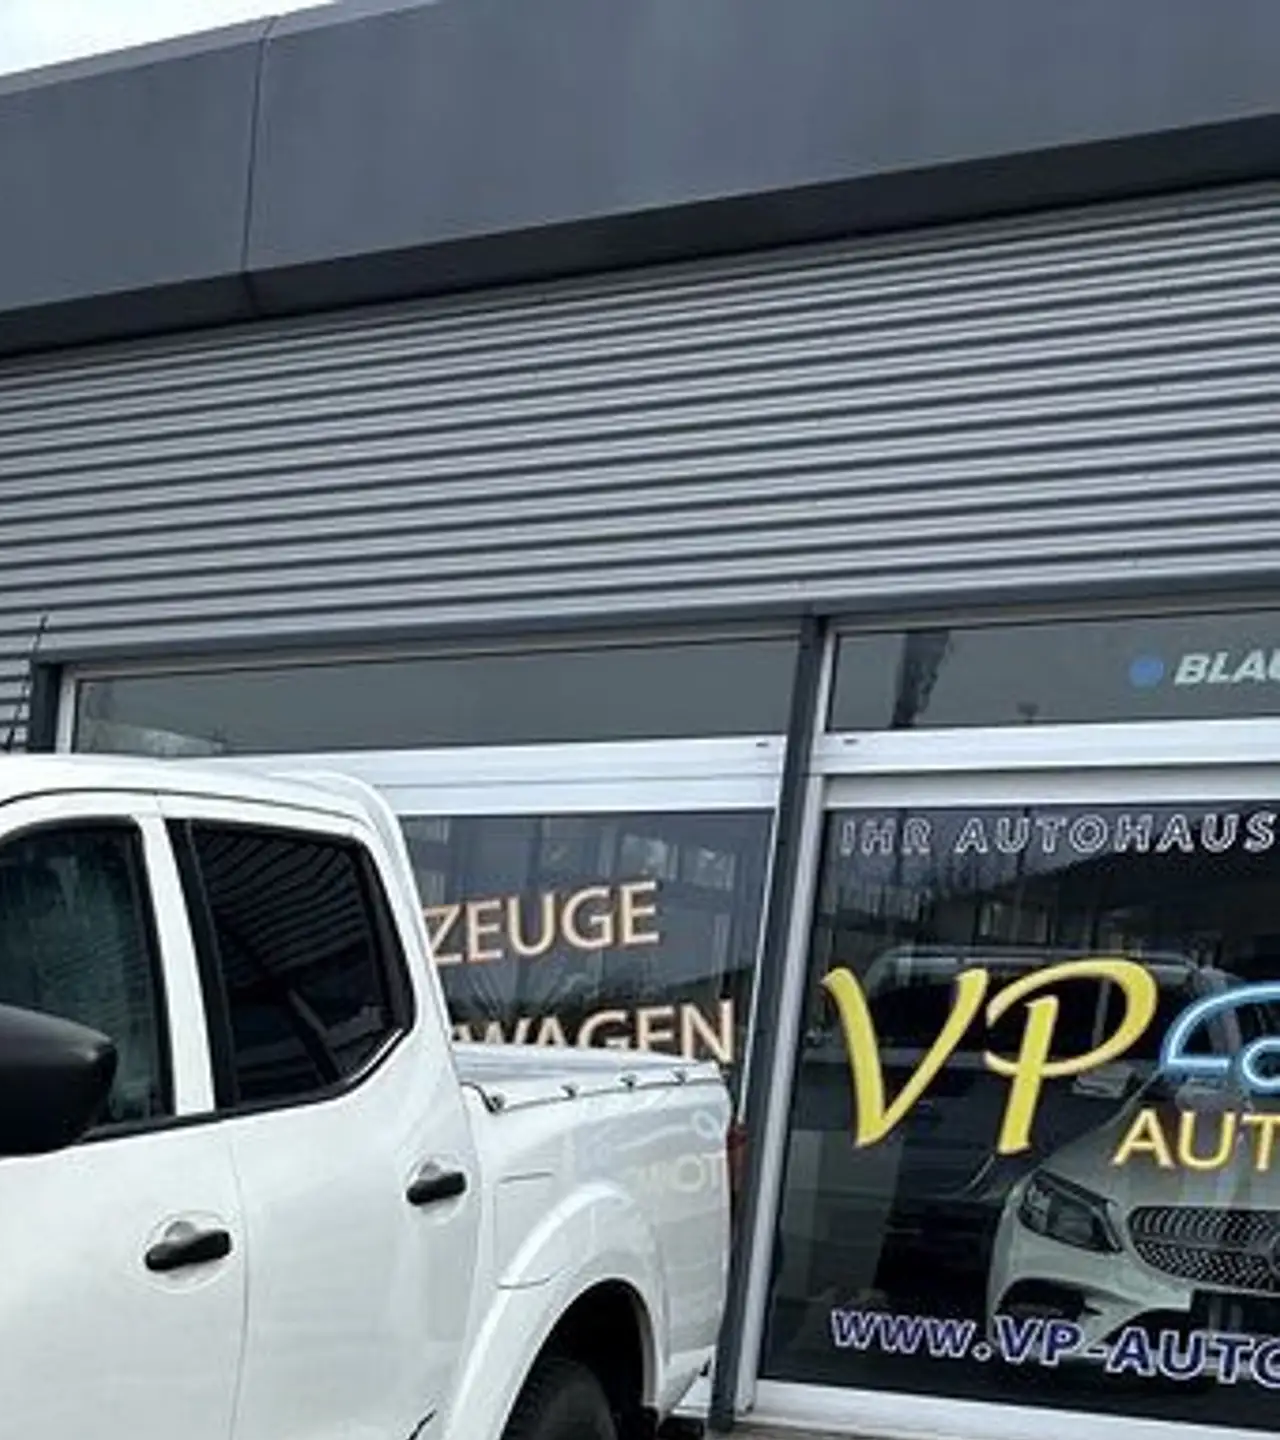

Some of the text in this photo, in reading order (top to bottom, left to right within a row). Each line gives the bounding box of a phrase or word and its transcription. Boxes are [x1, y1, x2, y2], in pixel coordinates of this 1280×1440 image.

[842, 811, 1277, 856] IHR AUTOHAUS
[820, 956, 1158, 1156] VP
[1111, 1107, 1280, 1172] AUT
